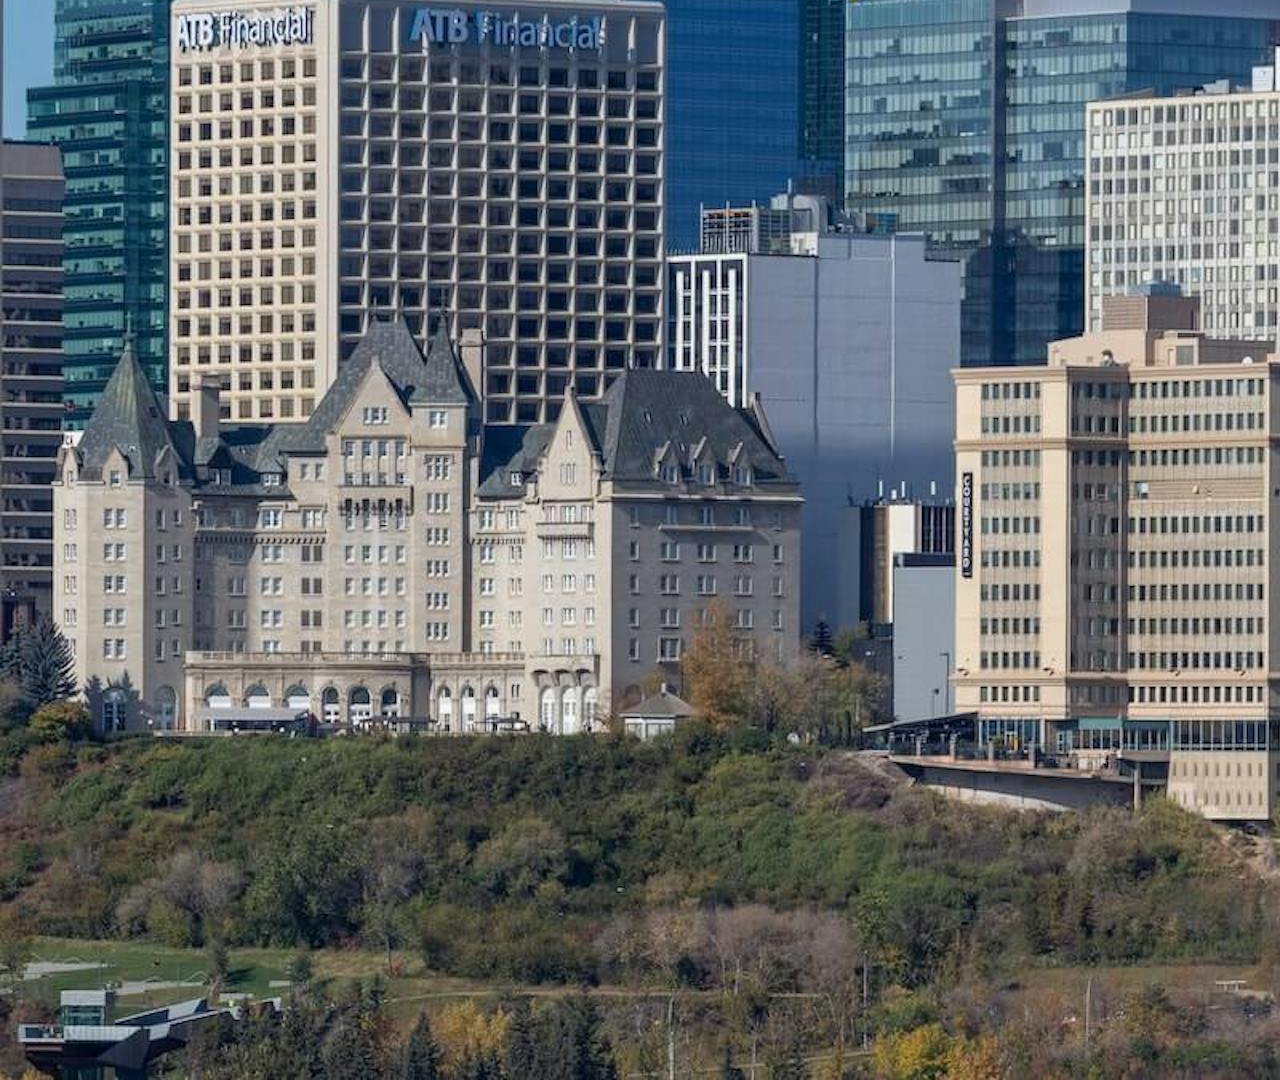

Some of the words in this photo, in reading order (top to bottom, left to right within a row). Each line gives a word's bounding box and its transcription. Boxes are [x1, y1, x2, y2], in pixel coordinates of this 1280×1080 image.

[178, 14, 214, 49] ATB
[219, 6, 309, 44] Financial
[410, 8, 469, 43] ATB
[476, 12, 603, 50] Financial
[962, 475, 972, 568] COURTYARD
